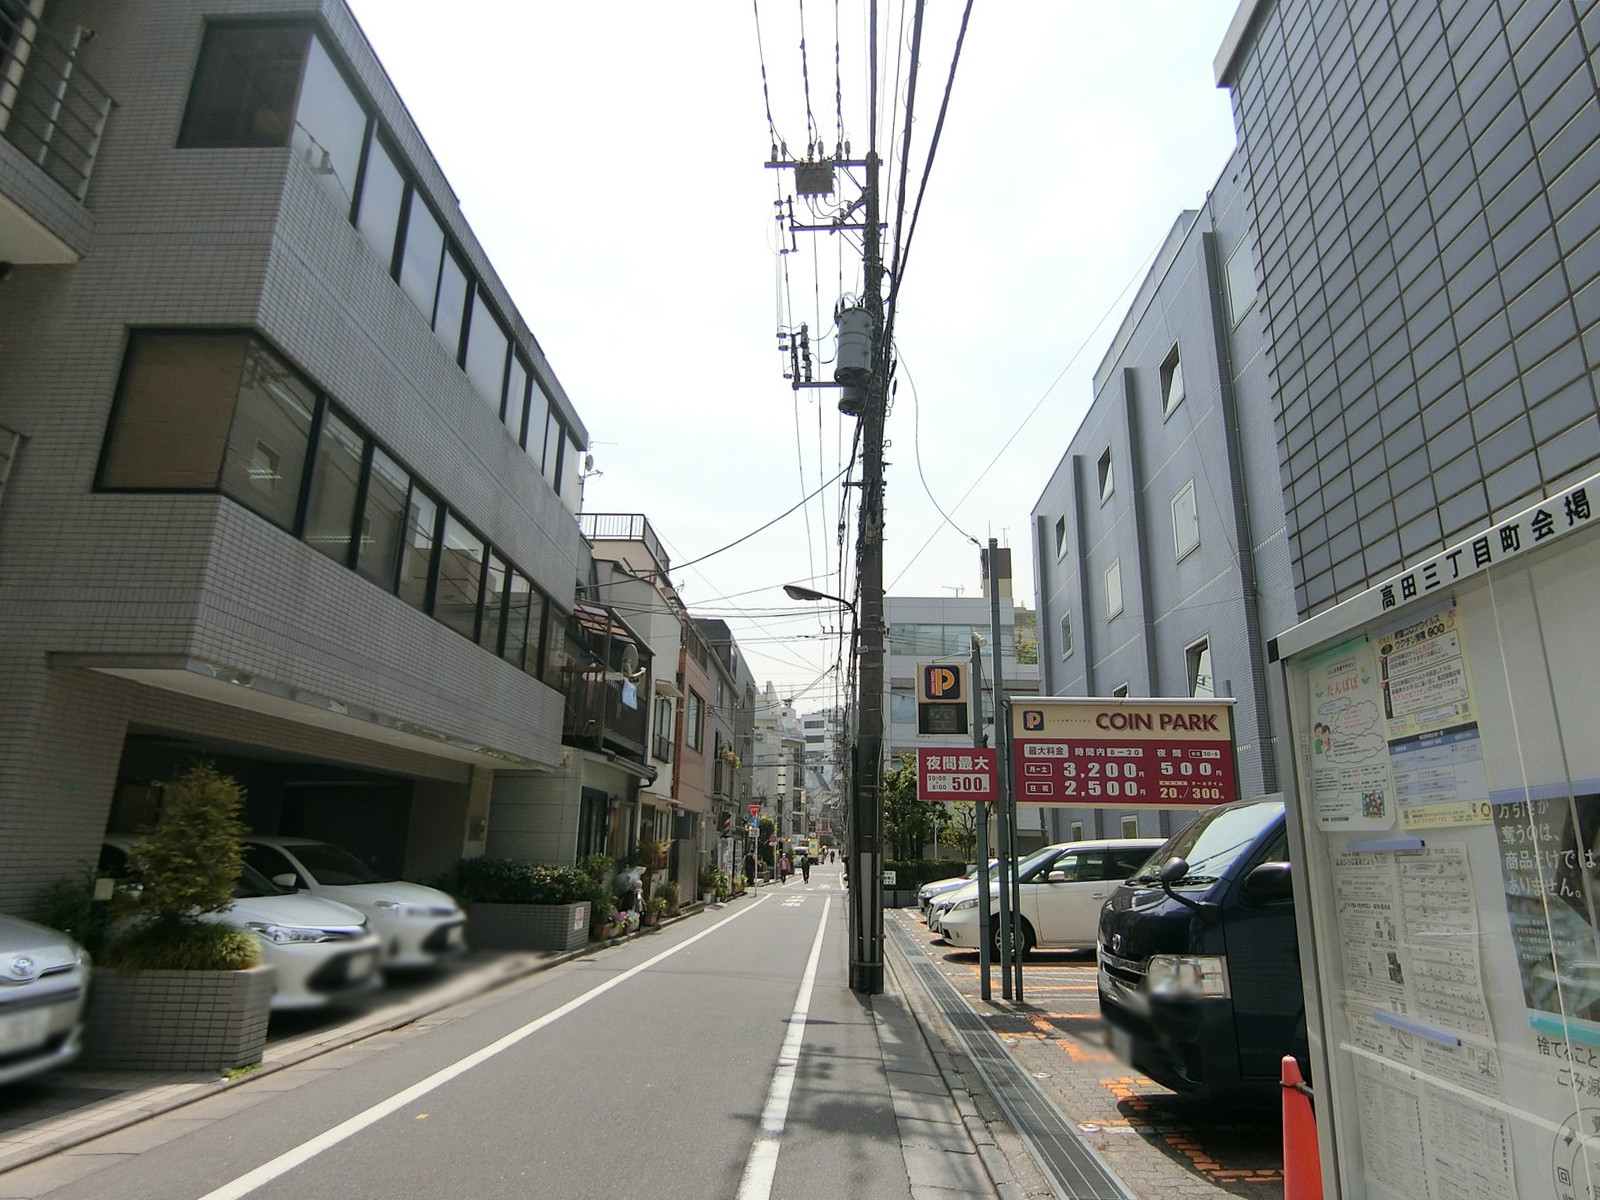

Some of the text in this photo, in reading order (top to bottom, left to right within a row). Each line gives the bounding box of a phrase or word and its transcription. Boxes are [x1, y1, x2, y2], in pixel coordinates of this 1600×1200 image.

[1380, 487, 1591, 611] 高田三丁目町会掲
[935, 668, 955, 696] P
[1095, 712, 1220, 731] COIN PARK
[1029, 746, 1064, 756] 最大料金
[1074, 747, 1105, 757] 時間内
[926, 755, 989, 771] 夜間最大
[1508, 877, 1582, 899] ありません。
